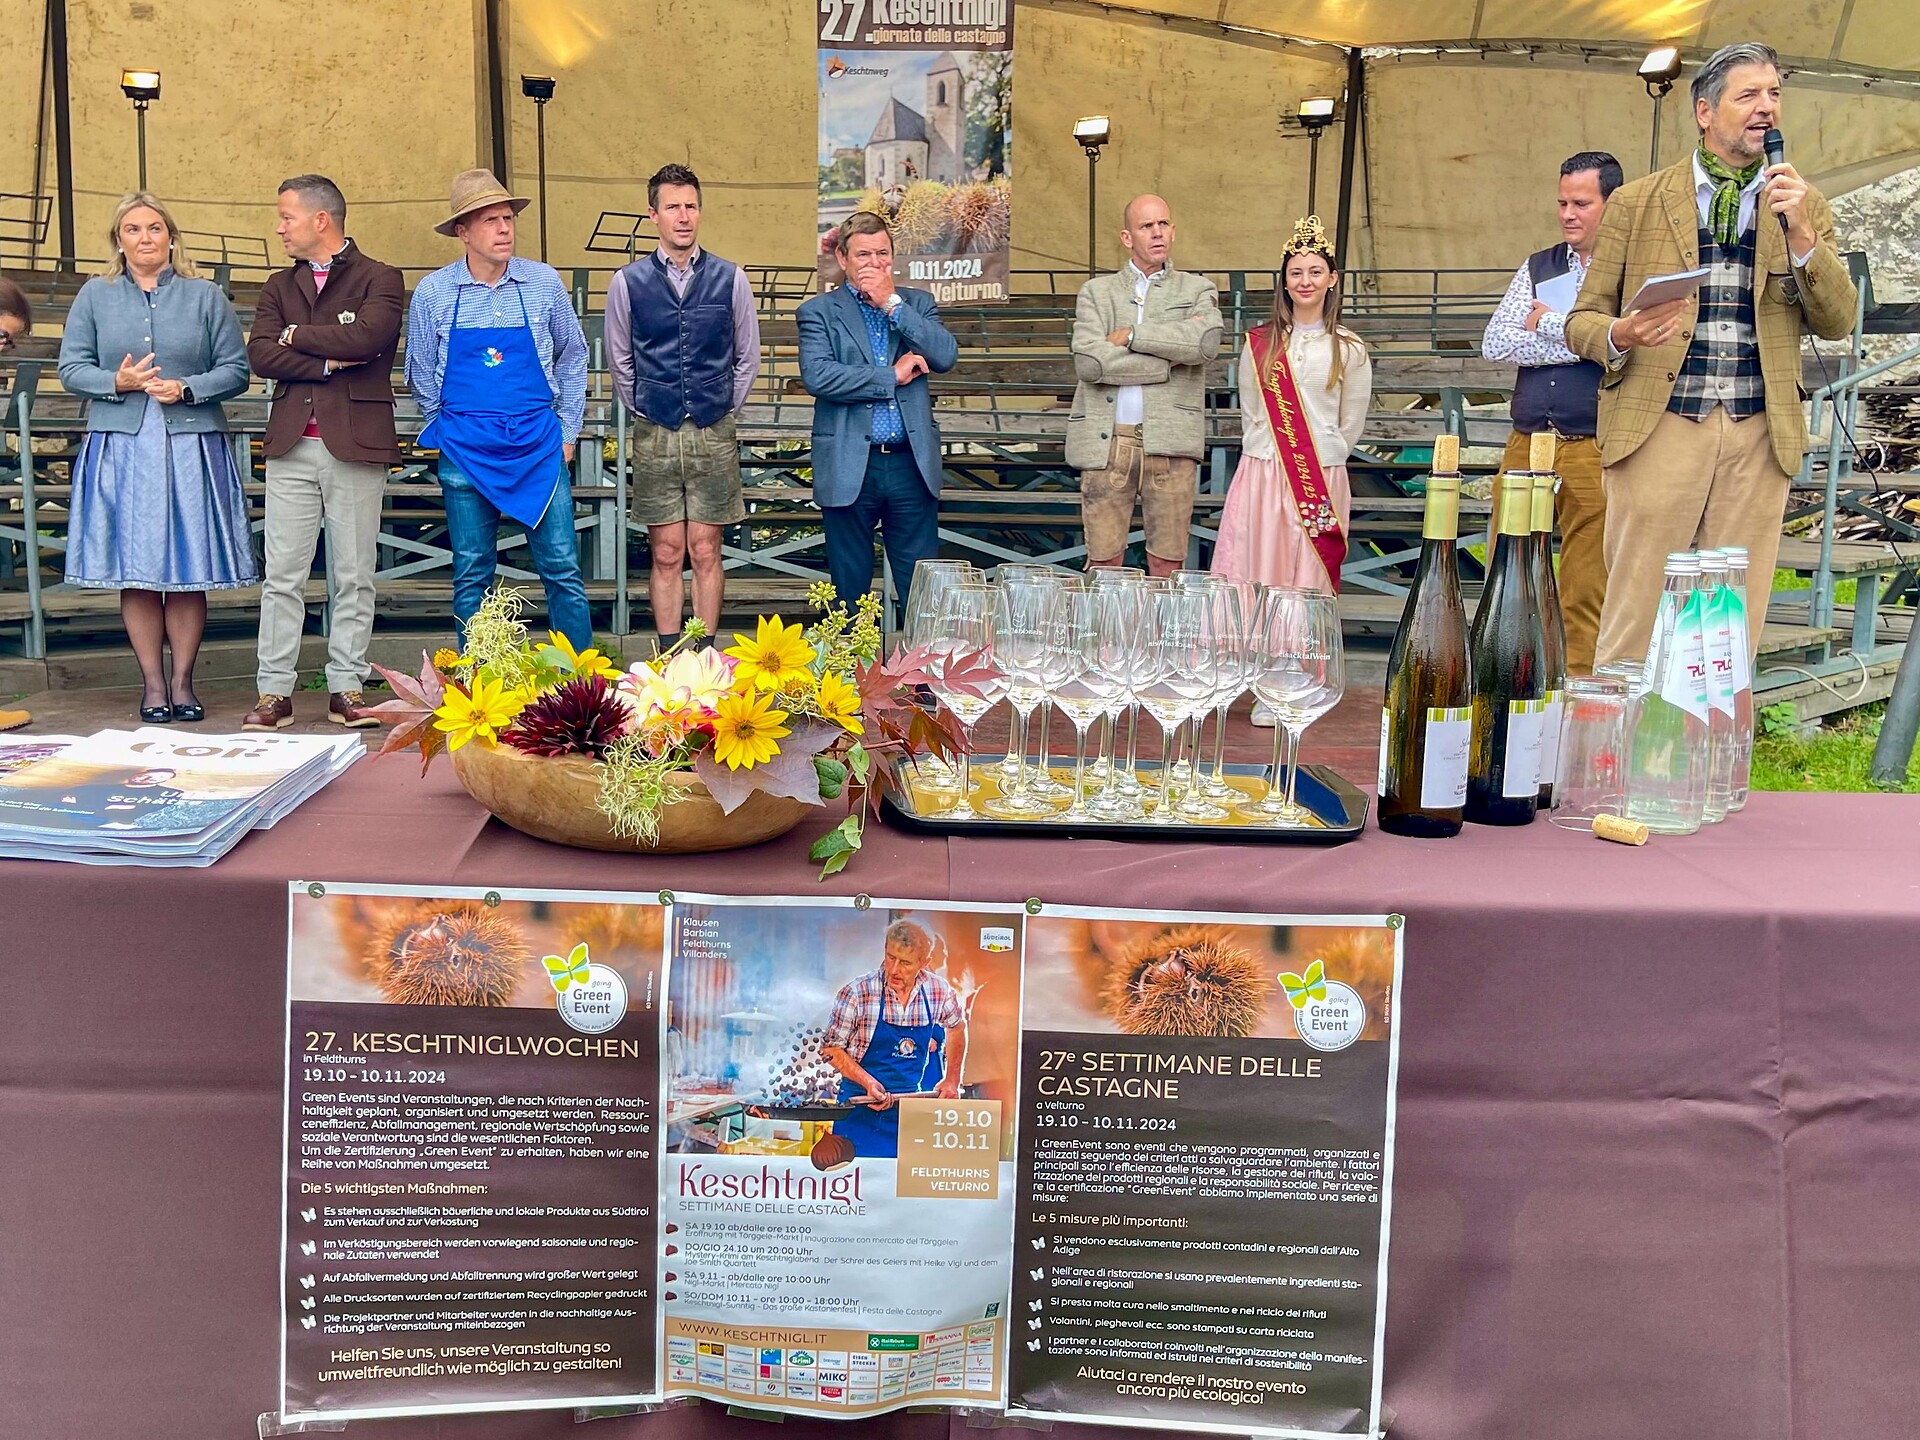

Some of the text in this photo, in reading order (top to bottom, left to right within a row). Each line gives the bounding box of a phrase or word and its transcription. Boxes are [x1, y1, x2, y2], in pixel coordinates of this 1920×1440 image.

[873, 27, 1006, 45] giornate delle castagne
[845, 66, 889, 78] Keschtnweg
[908, 258, 983, 281] 10.11.2024
[929, 281, 1001, 302] Velturno
[1293, 453, 1318, 499] 2024/25
[683, 918, 719, 928] Klausen
[683, 928, 719, 938] Barbian
[683, 939, 731, 949] Feldthurns
[682, 949, 728, 959] Villanders
[573, 988, 611, 1001] Green
[574, 1002, 611, 1014] Event
[1311, 1005, 1349, 1018] Green
[1312, 1018, 1348, 1031] Event
[306, 1031, 638, 1058] 27. KESCHTNIGLWOCHEN
[303, 1054, 367, 1064] in Feldthurns
[1082, 1052, 1232, 1075] SETTIMANE
[1240, 1057, 1322, 1078] DELLE
[304, 1068, 346, 1082] 19.10
[361, 1069, 446, 1084] 10.11.2024
[1038, 1076, 1179, 1099] CASTAGNE
[302, 1092, 336, 1102] Green
[338, 1092, 376, 1103] Events
[378, 1093, 400, 1104] sind
[498, 1095, 516, 1105] die
[517, 1095, 545, 1106] nach
[547, 1096, 593, 1106] Kriterien
[594, 1096, 614, 1107] der
[616, 1097, 650, 1107] Nach-
[1044, 1100, 1085, 1110] Velturno
[302, 1106, 353, 1118] haltigkeit
[405, 1107, 464, 1119] organisiert
[467, 1108, 488, 1117] und
[492, 1109, 550, 1120] umgesetzt
[601, 1110, 650, 1120] Ressour-
[934, 1109, 992, 1128] 19.10
[302, 1119, 650, 1135] ceneffizienz, Abfallmanagement, regionale Wertschöpfung sowie
[1093, 1116, 1177, 1131] 10.11.2024
[932, 1132, 990, 1150] 10.11
[1042, 1139, 1102, 1150] GreenEvent
[1105, 1142, 1131, 1151] sono
[1134, 1142, 1166, 1152] eventi
[1169, 1142, 1188, 1153] che
[1191, 1145, 1237, 1157] vengono
[1313, 1149, 1370, 1161] organizzati
[1373, 1152, 1381, 1160] e
[911, 1167, 990, 1179] FELDTHURNS
[301, 1183, 322, 1194] Die
[324, 1183, 332, 1194] 5
[334, 1182, 405, 1196] wichtigsten
[680, 1163, 864, 1205] Keschtnigl
[930, 1180, 990, 1192] VELTURNO
[679, 1200, 866, 1215] SETTIMANE DELLE CASTAGNE
[685, 1222, 699, 1230] SA
[1032, 1212, 1047, 1223] Le
[1049, 1213, 1056, 1223] 5
[1060, 1214, 1100, 1224] misure
[1102, 1214, 1121, 1227] più
[796, 1247, 814, 1256] Uhr
[684, 1271, 698, 1280] SA
[767, 1275, 783, 1283] ore
[814, 1276, 831, 1284] Uhr
[322, 1289, 648, 1303] Alle Drucksorten wurden auf zertifiziertem Recyclingpapier gedruckt
[842, 1298, 860, 1307] Uhr
[331, 1348, 379, 1362] Helfen
[381, 1347, 404, 1360] Sie
[440, 1346, 490, 1357] unsere
[492, 1342, 591, 1356] Veranstaltung
[594, 1343, 611, 1353] so
[318, 1357, 622, 1381] umweltfreundlich wie möglich zu gestalten!
[1076, 1366, 1306, 1394] Aiutaci a rendere il nostro evento
[1116, 1384, 1264, 1406] ancora più ecologico!
